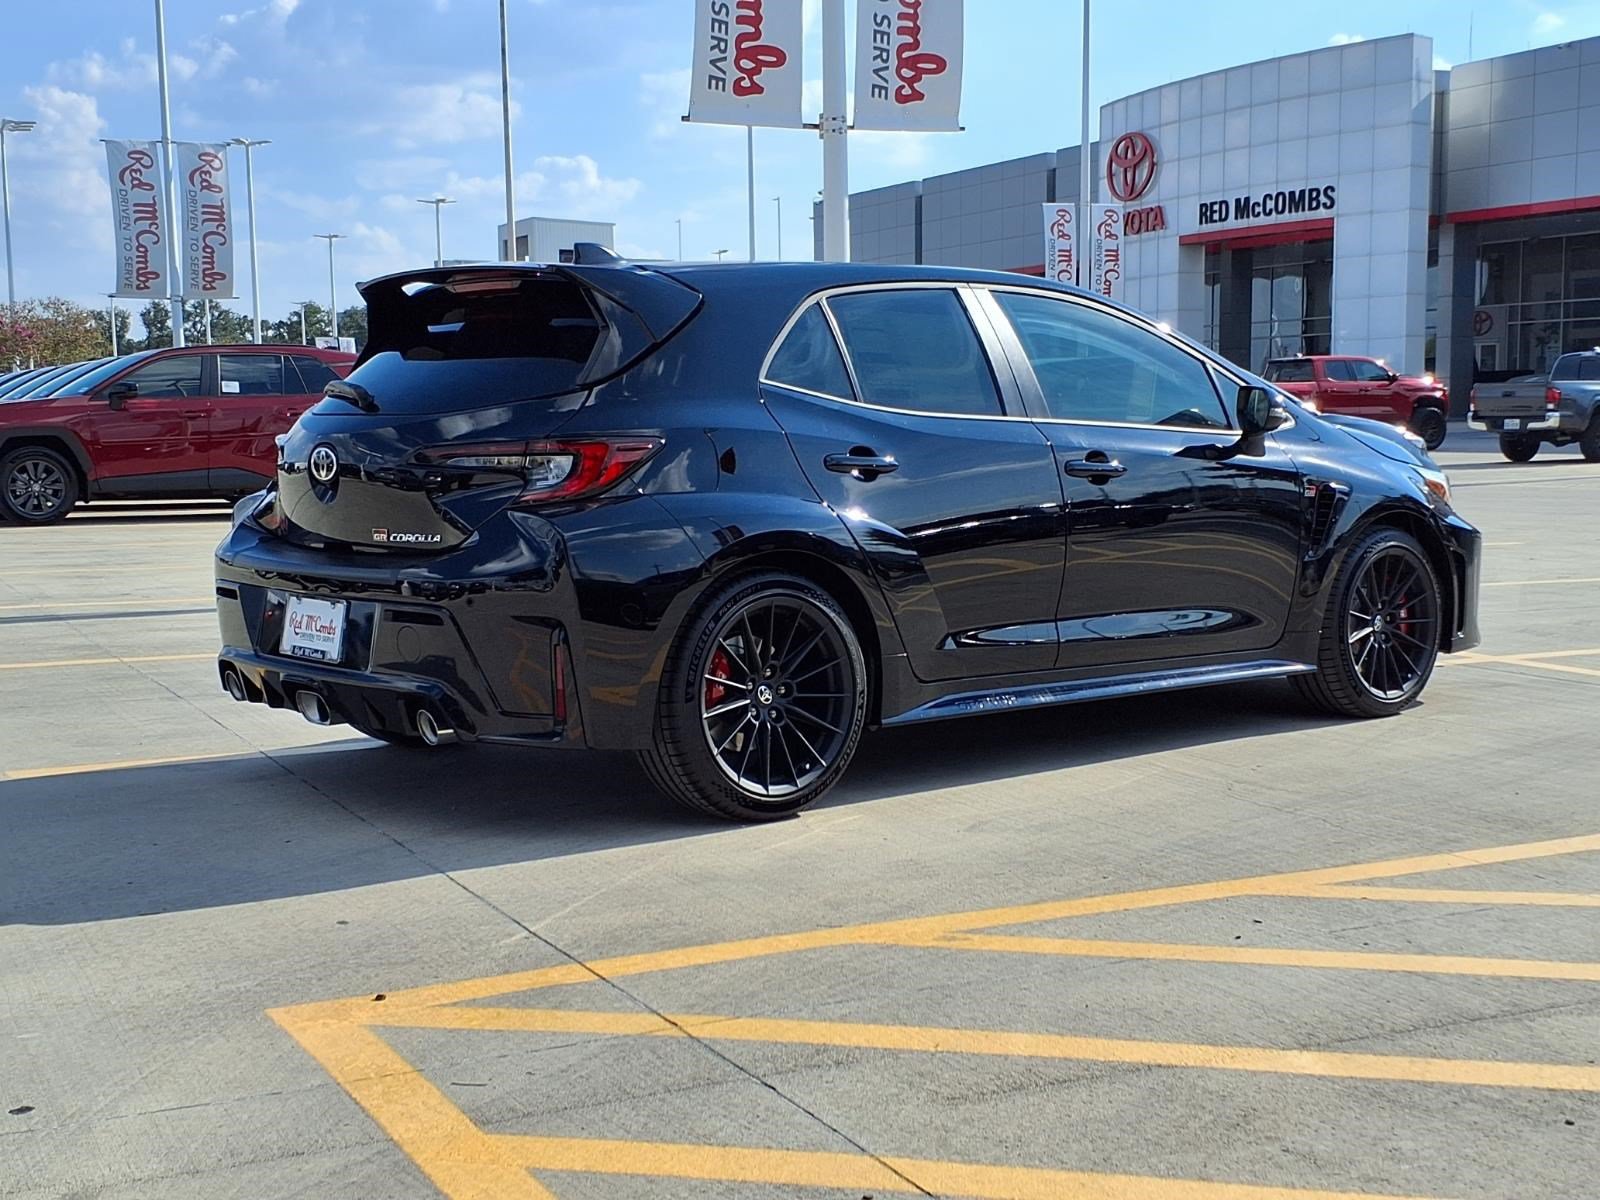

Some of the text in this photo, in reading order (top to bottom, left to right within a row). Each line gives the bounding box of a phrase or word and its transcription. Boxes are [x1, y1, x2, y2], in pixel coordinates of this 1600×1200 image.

[708, 0, 730, 92] SERVE
[871, 12, 891, 100] SERVE
[119, 150, 160, 290] Red McCombs
[189, 151, 227, 291] Red McCombs
[1050, 208, 1072, 240] Red
[1097, 208, 1120, 240] Red
[1199, 186, 1336, 226] RED McCOMBS
[118, 189, 134, 289] DRIVEN TO SERVE
[189, 190, 200, 290] DRIVEN TO SERVE
[1096, 275, 1103, 286] TO
[390, 533, 441, 543] COROLLA
[290, 611, 336, 636] Red McCombs
[689, 620, 715, 683] MICHELIN
